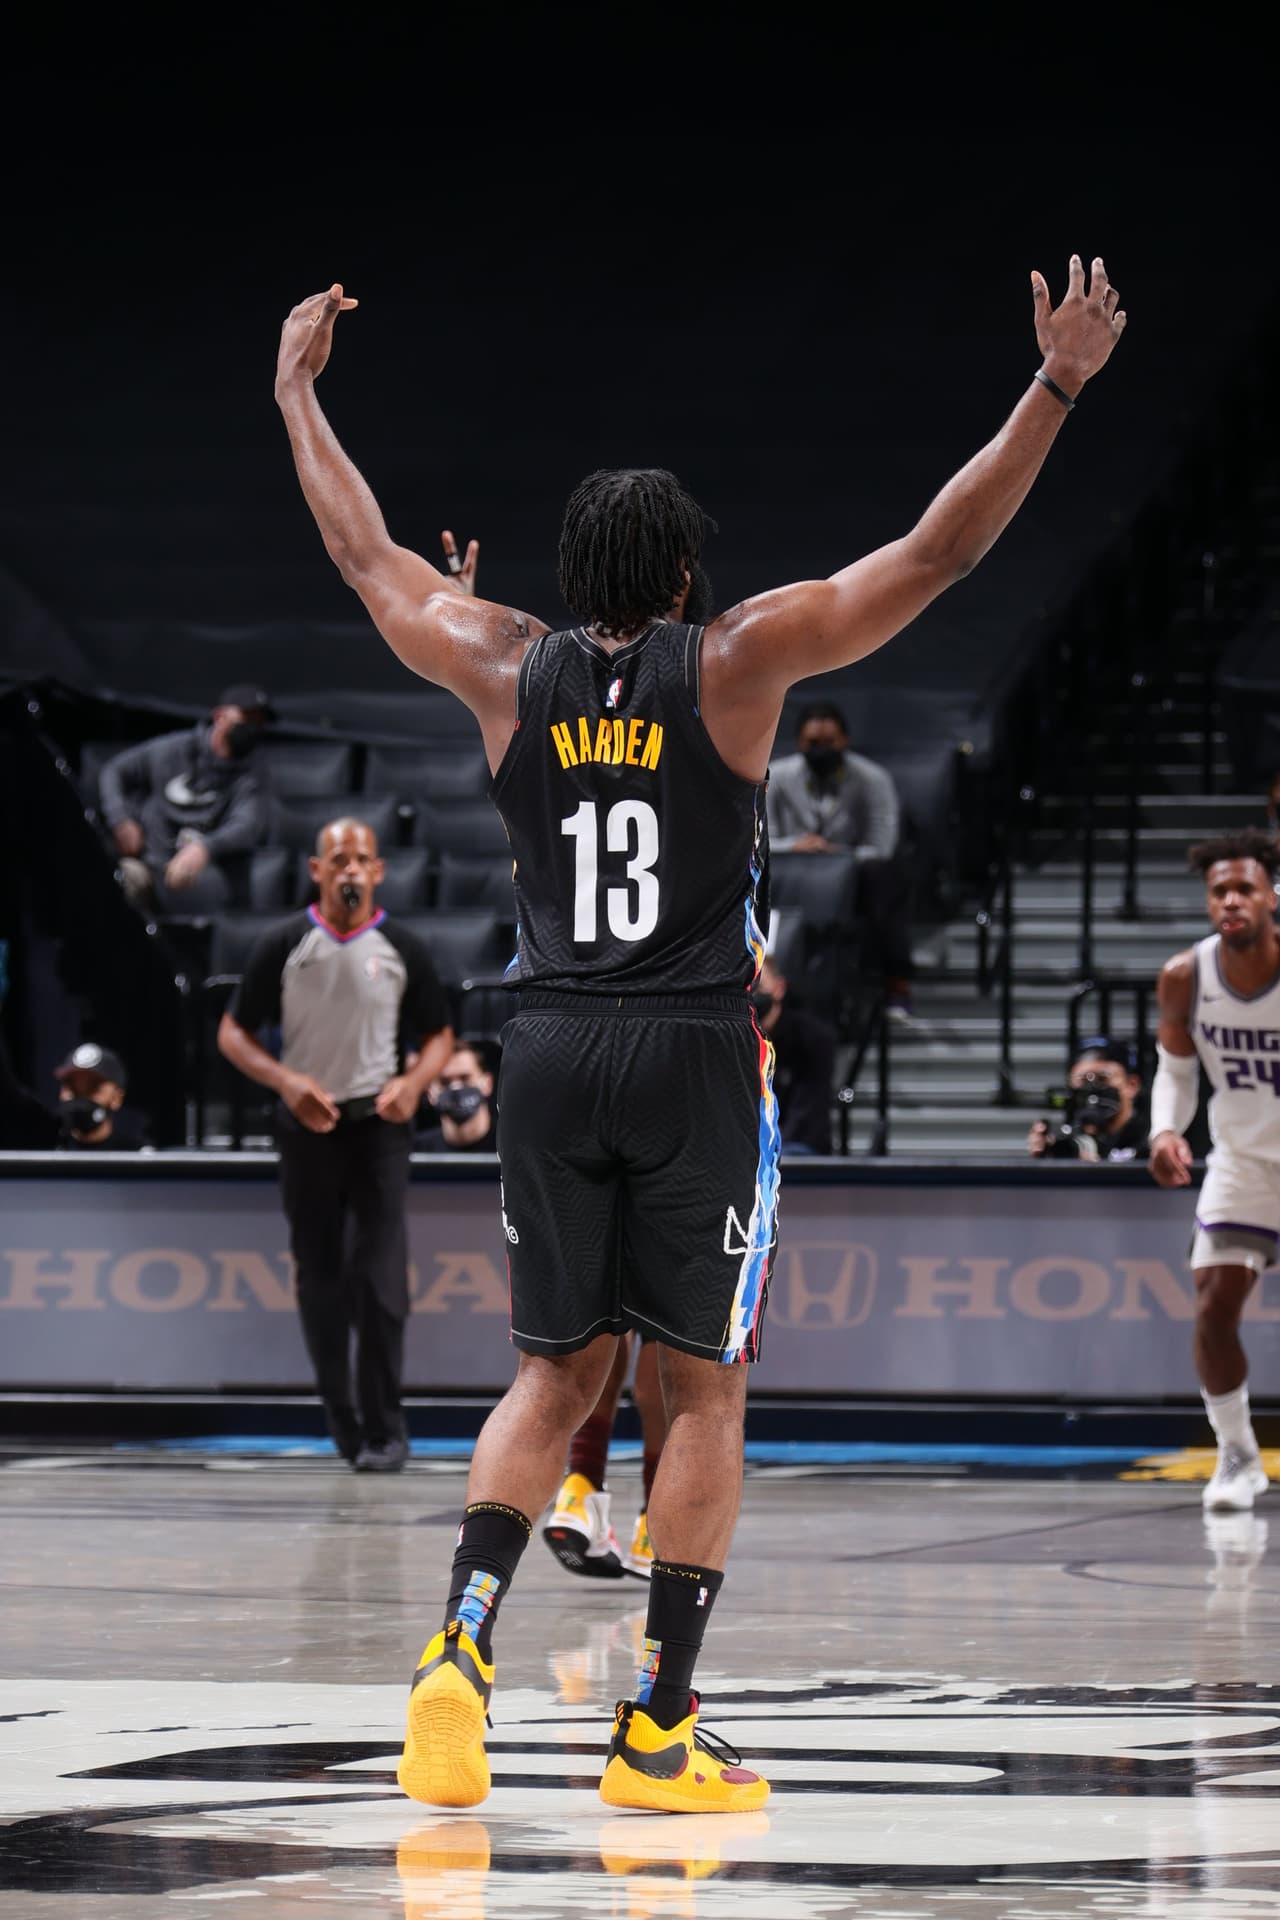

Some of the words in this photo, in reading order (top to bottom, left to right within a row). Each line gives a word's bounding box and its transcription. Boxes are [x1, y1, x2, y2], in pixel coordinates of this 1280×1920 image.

[551, 717, 663, 770] HARDEN
[561, 800, 660, 942] 13
[1222, 1057, 1280, 1097] 24
[0, 1249, 511, 1313] HONA
